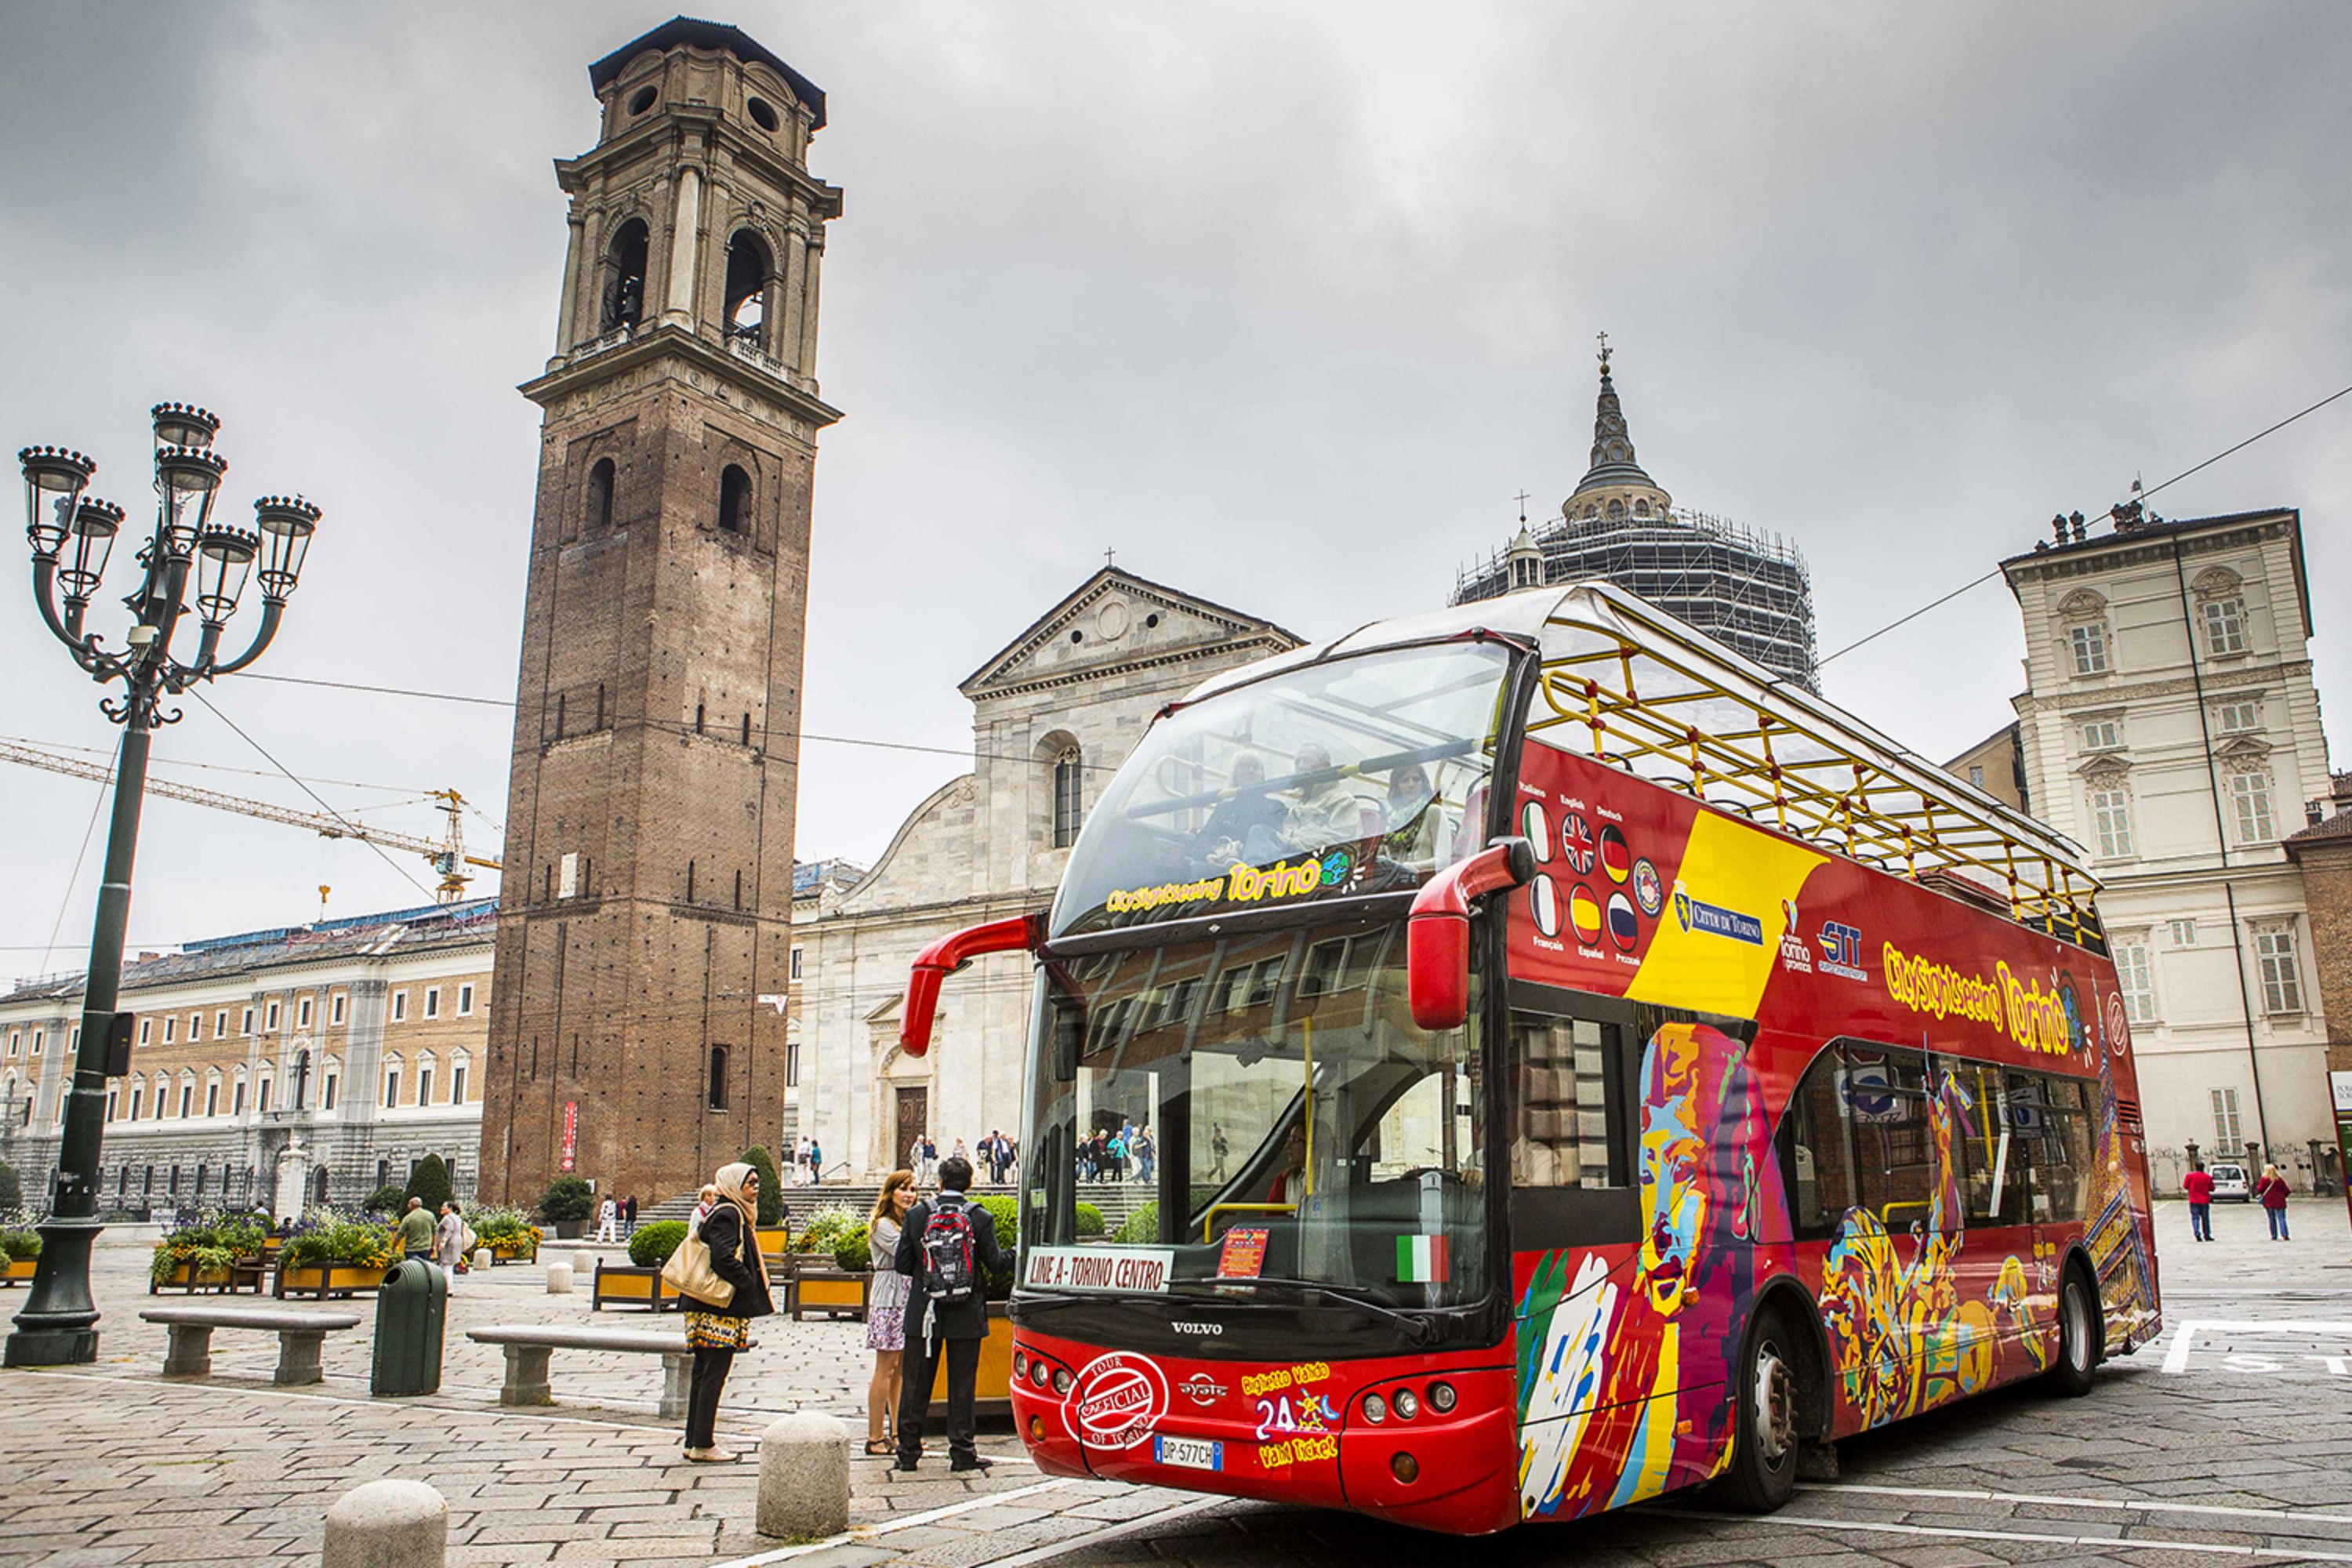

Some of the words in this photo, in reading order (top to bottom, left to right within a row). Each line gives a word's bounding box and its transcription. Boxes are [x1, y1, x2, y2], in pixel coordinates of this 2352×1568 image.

[1560, 793, 1585, 810] English
[1596, 805, 1623, 822] Deutsch
[1229, 859, 1321, 901] Torino
[1817, 920, 1861, 967] GTT
[1995, 960, 2069, 1055] Torino
[1029, 1255, 1054, 1285] LINE
[1115, 1258, 1163, 1292] CENTRO
[1171, 1321, 1223, 1335] VOLVO
[1091, 1356, 1123, 1376] TOUR
[1082, 1383, 1150, 1417] OFFICIAL
[1256, 1396, 1296, 1440] 24
[1091, 1432, 1105, 1445] OF
